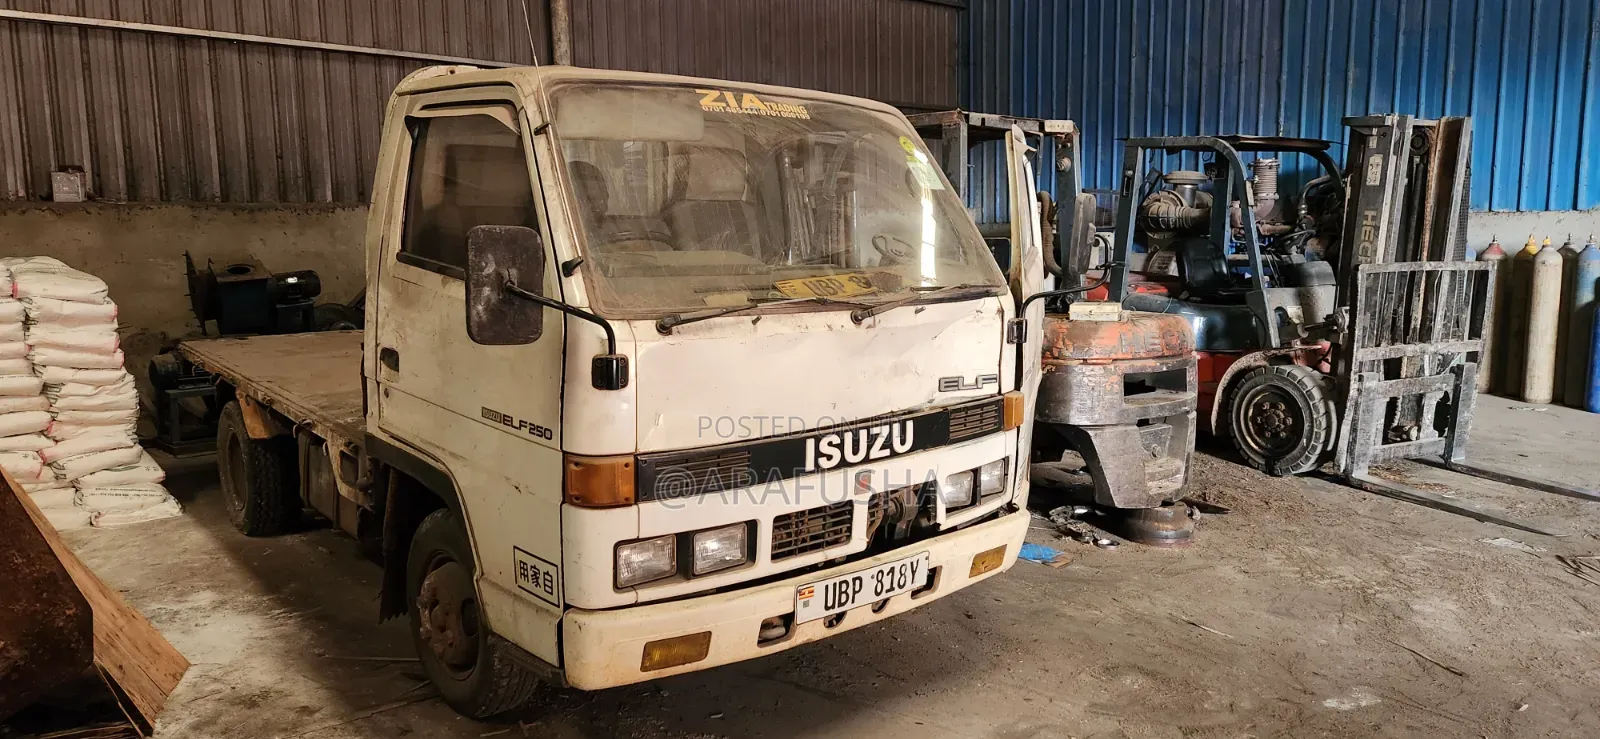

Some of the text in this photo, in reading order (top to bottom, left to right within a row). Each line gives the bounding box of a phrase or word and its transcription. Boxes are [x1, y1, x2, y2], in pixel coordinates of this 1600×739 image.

[695, 88, 807, 114] ZIA TRADING
[801, 275, 872, 297] UBP 8
[938, 374, 998, 392] ELF
[804, 420, 914, 472] ISUZU
[824, 558, 920, 612] UBP 818Y
